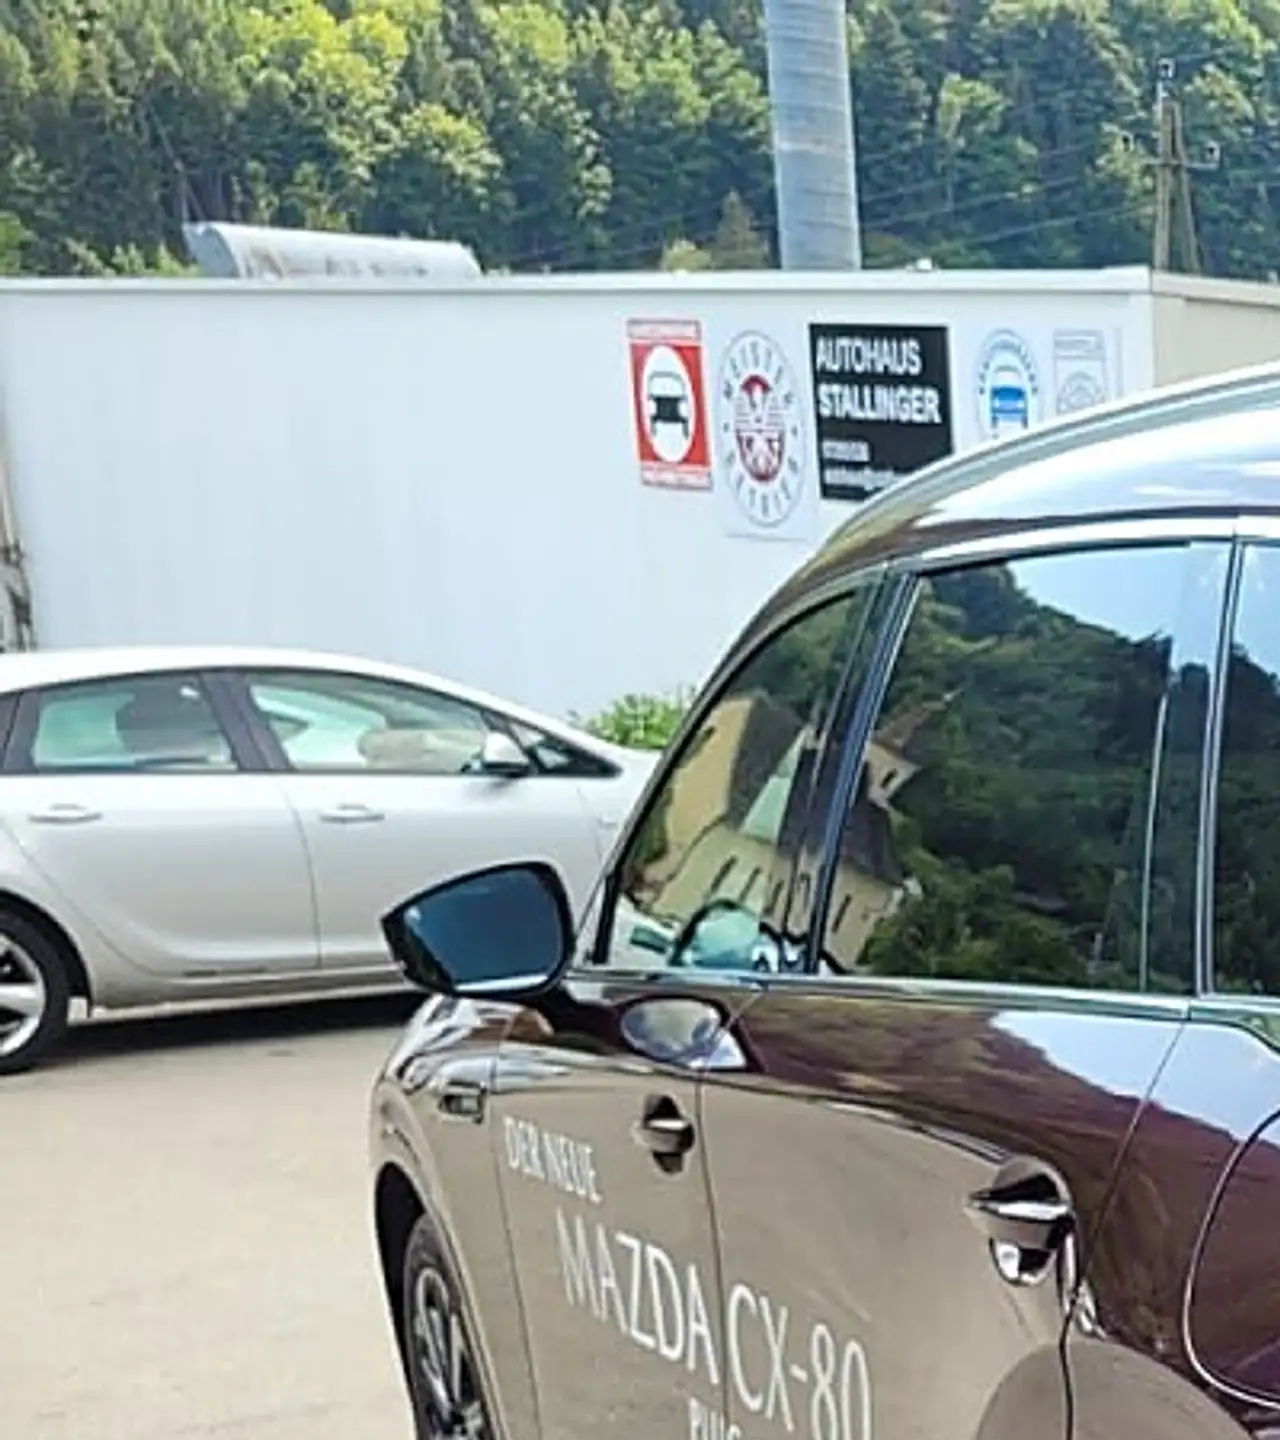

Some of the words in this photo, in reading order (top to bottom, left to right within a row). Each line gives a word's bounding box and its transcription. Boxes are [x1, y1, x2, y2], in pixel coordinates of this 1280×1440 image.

[816, 336, 922, 376] AUTOHAUS
[818, 383, 942, 424] STALLINGER
[504, 1117, 542, 1180] DER
[556, 1207, 718, 1385] MAZDA
